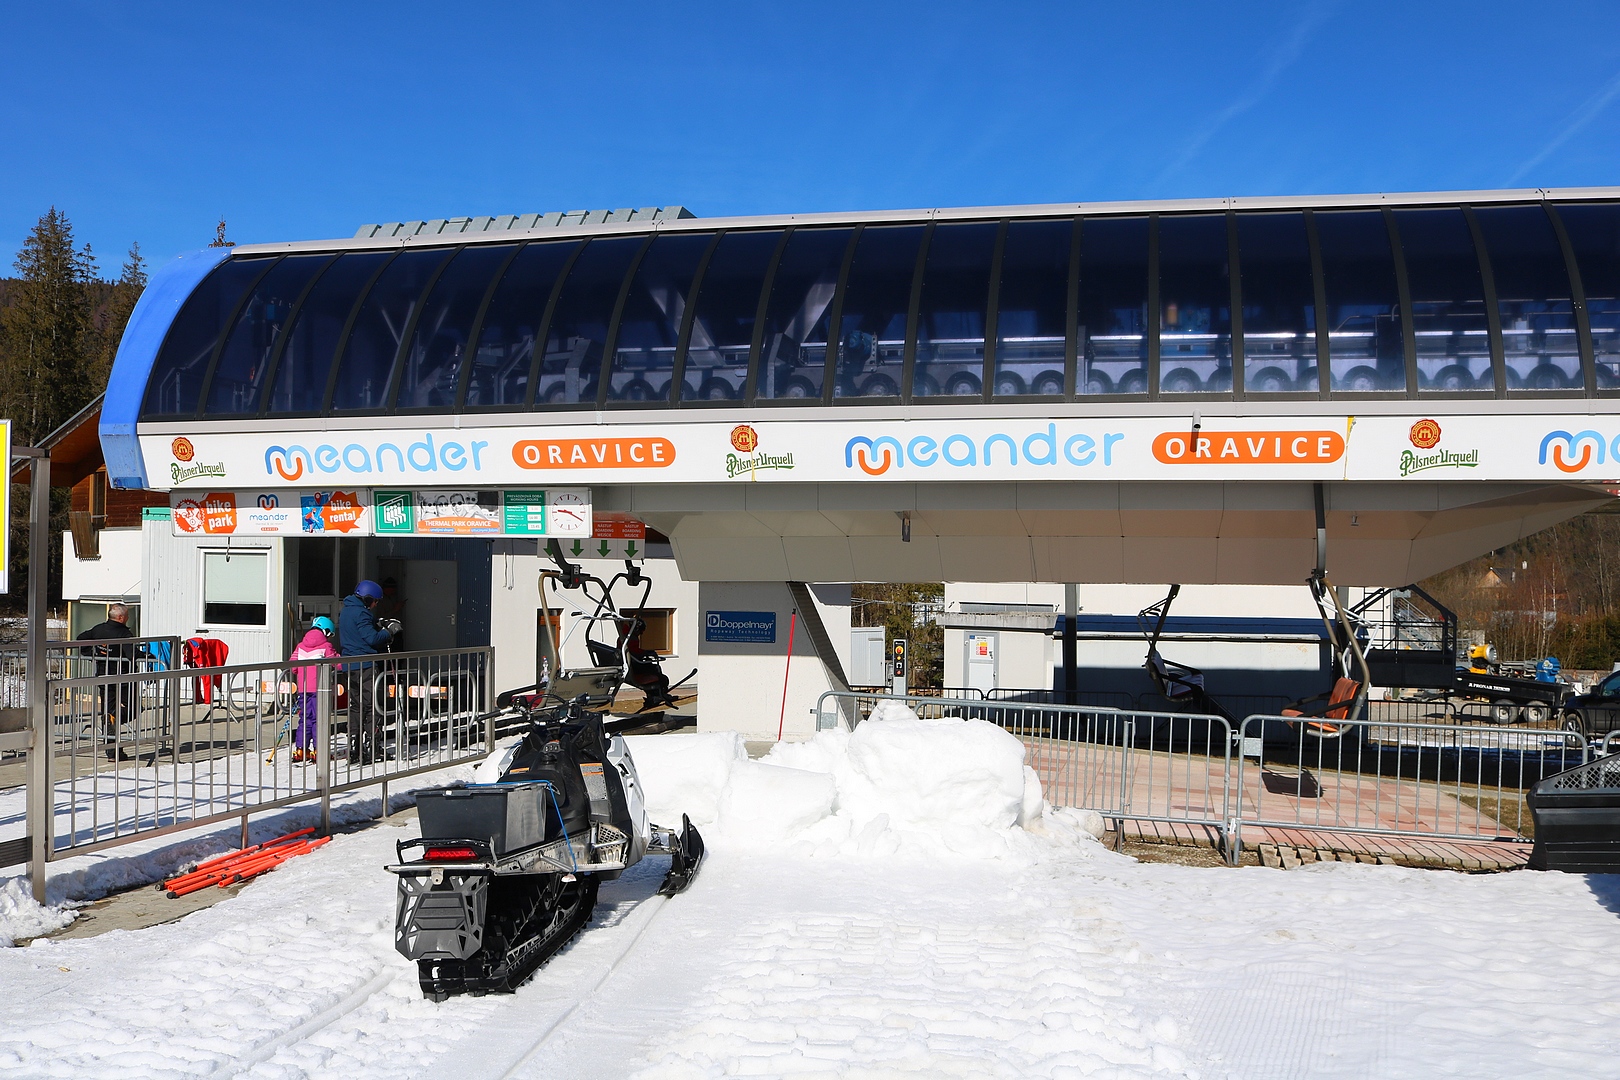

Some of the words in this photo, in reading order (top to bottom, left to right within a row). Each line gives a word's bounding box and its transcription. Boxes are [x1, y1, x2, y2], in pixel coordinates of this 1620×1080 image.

[265, 433, 488, 481] meander
[523, 443, 665, 464] ORAVICE
[845, 423, 1124, 476] meander
[1165, 436, 1332, 459] ORAVICE
[171, 462, 198, 485] Pilsner
[196, 461, 225, 477] Urquell
[726, 453, 760, 478] Pilsner
[759, 452, 794, 470] Urquell
[1400, 450, 1440, 477] Pilsner
[1439, 449, 1478, 468] Urquell
[206, 500, 232, 514] bike
[330, 500, 352, 511] bike
[209, 514, 234, 530] park
[249, 513, 288, 521] meander
[330, 512, 357, 522] rental
[720, 620, 774, 630] Doppelmayr
